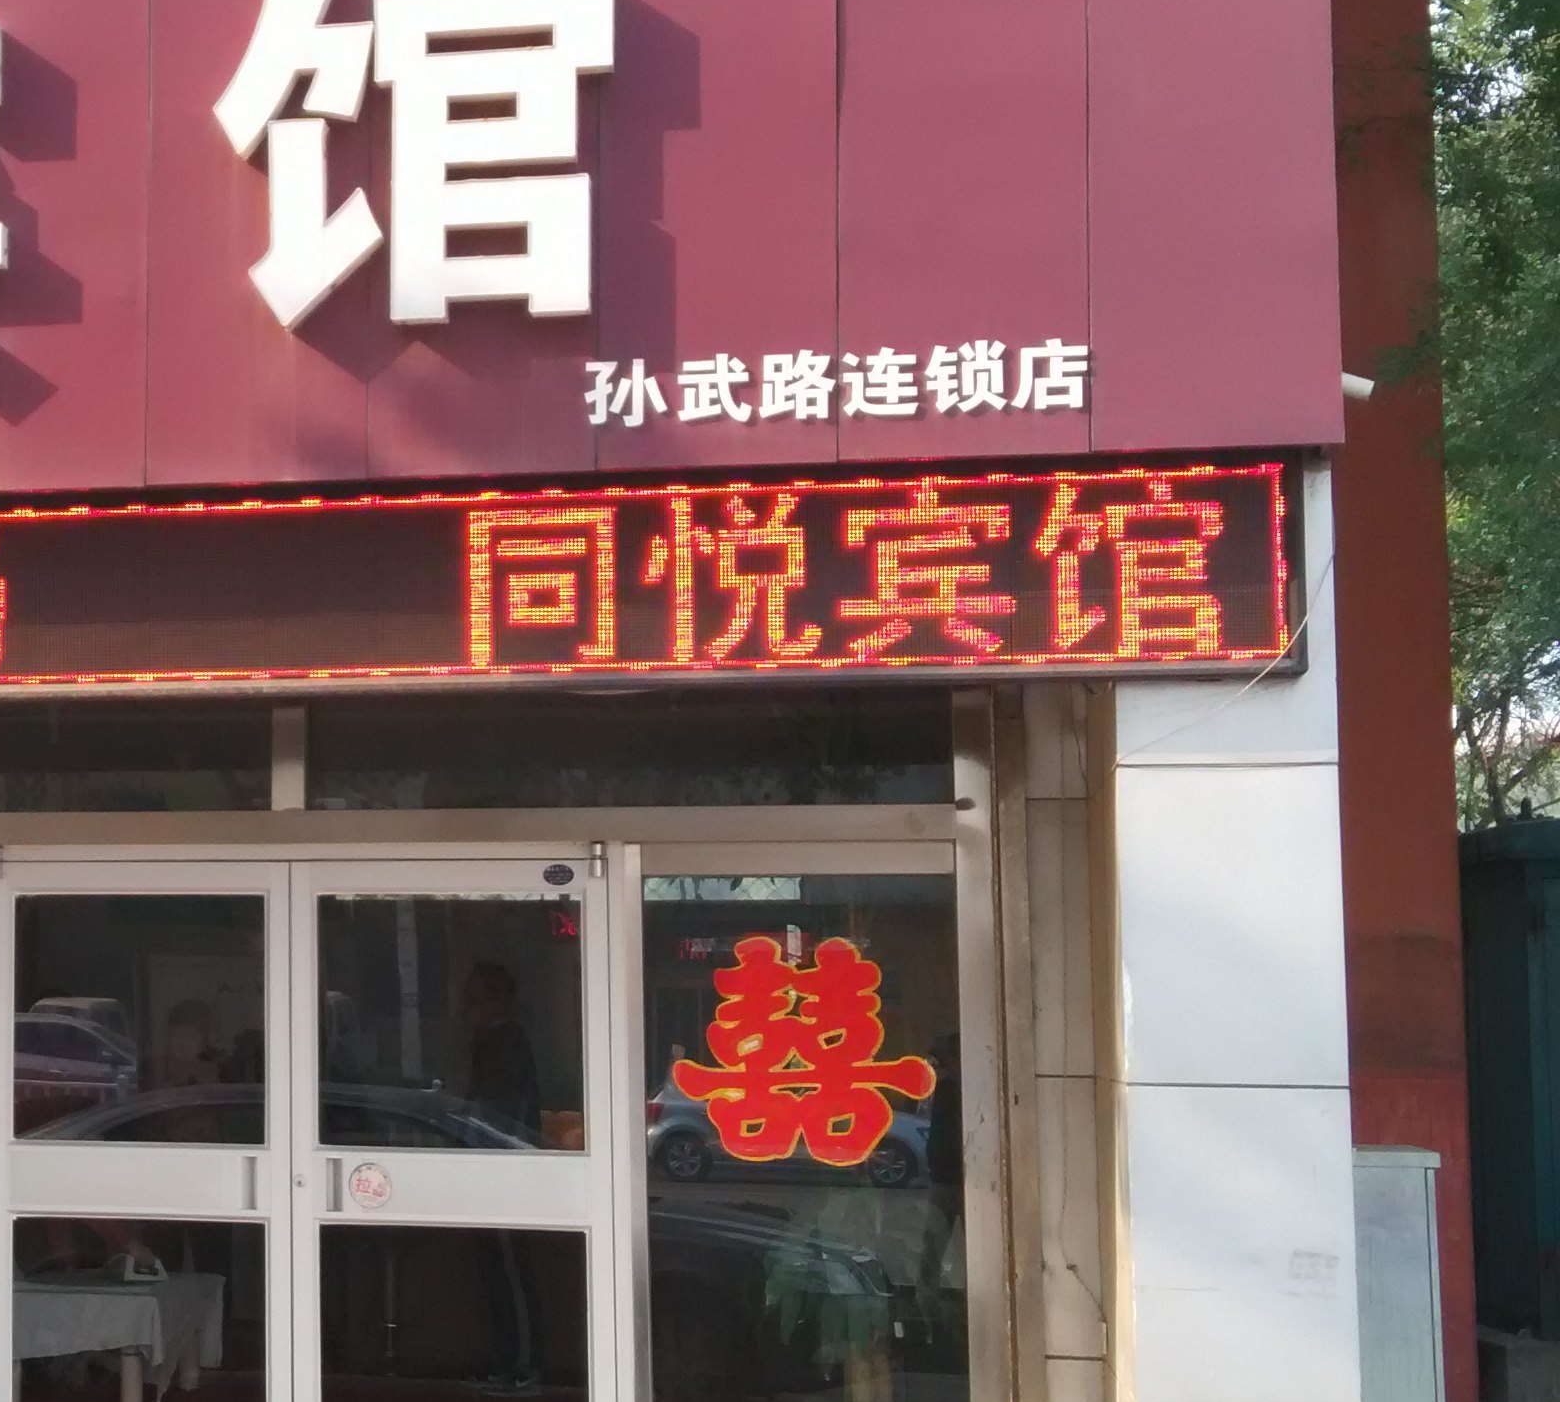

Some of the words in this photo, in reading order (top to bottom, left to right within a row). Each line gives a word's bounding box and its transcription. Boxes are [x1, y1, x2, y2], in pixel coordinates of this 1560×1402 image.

[584, 337, 1090, 428] 孙武路连锁店
[467, 477, 1225, 669] 同悦宾馆
